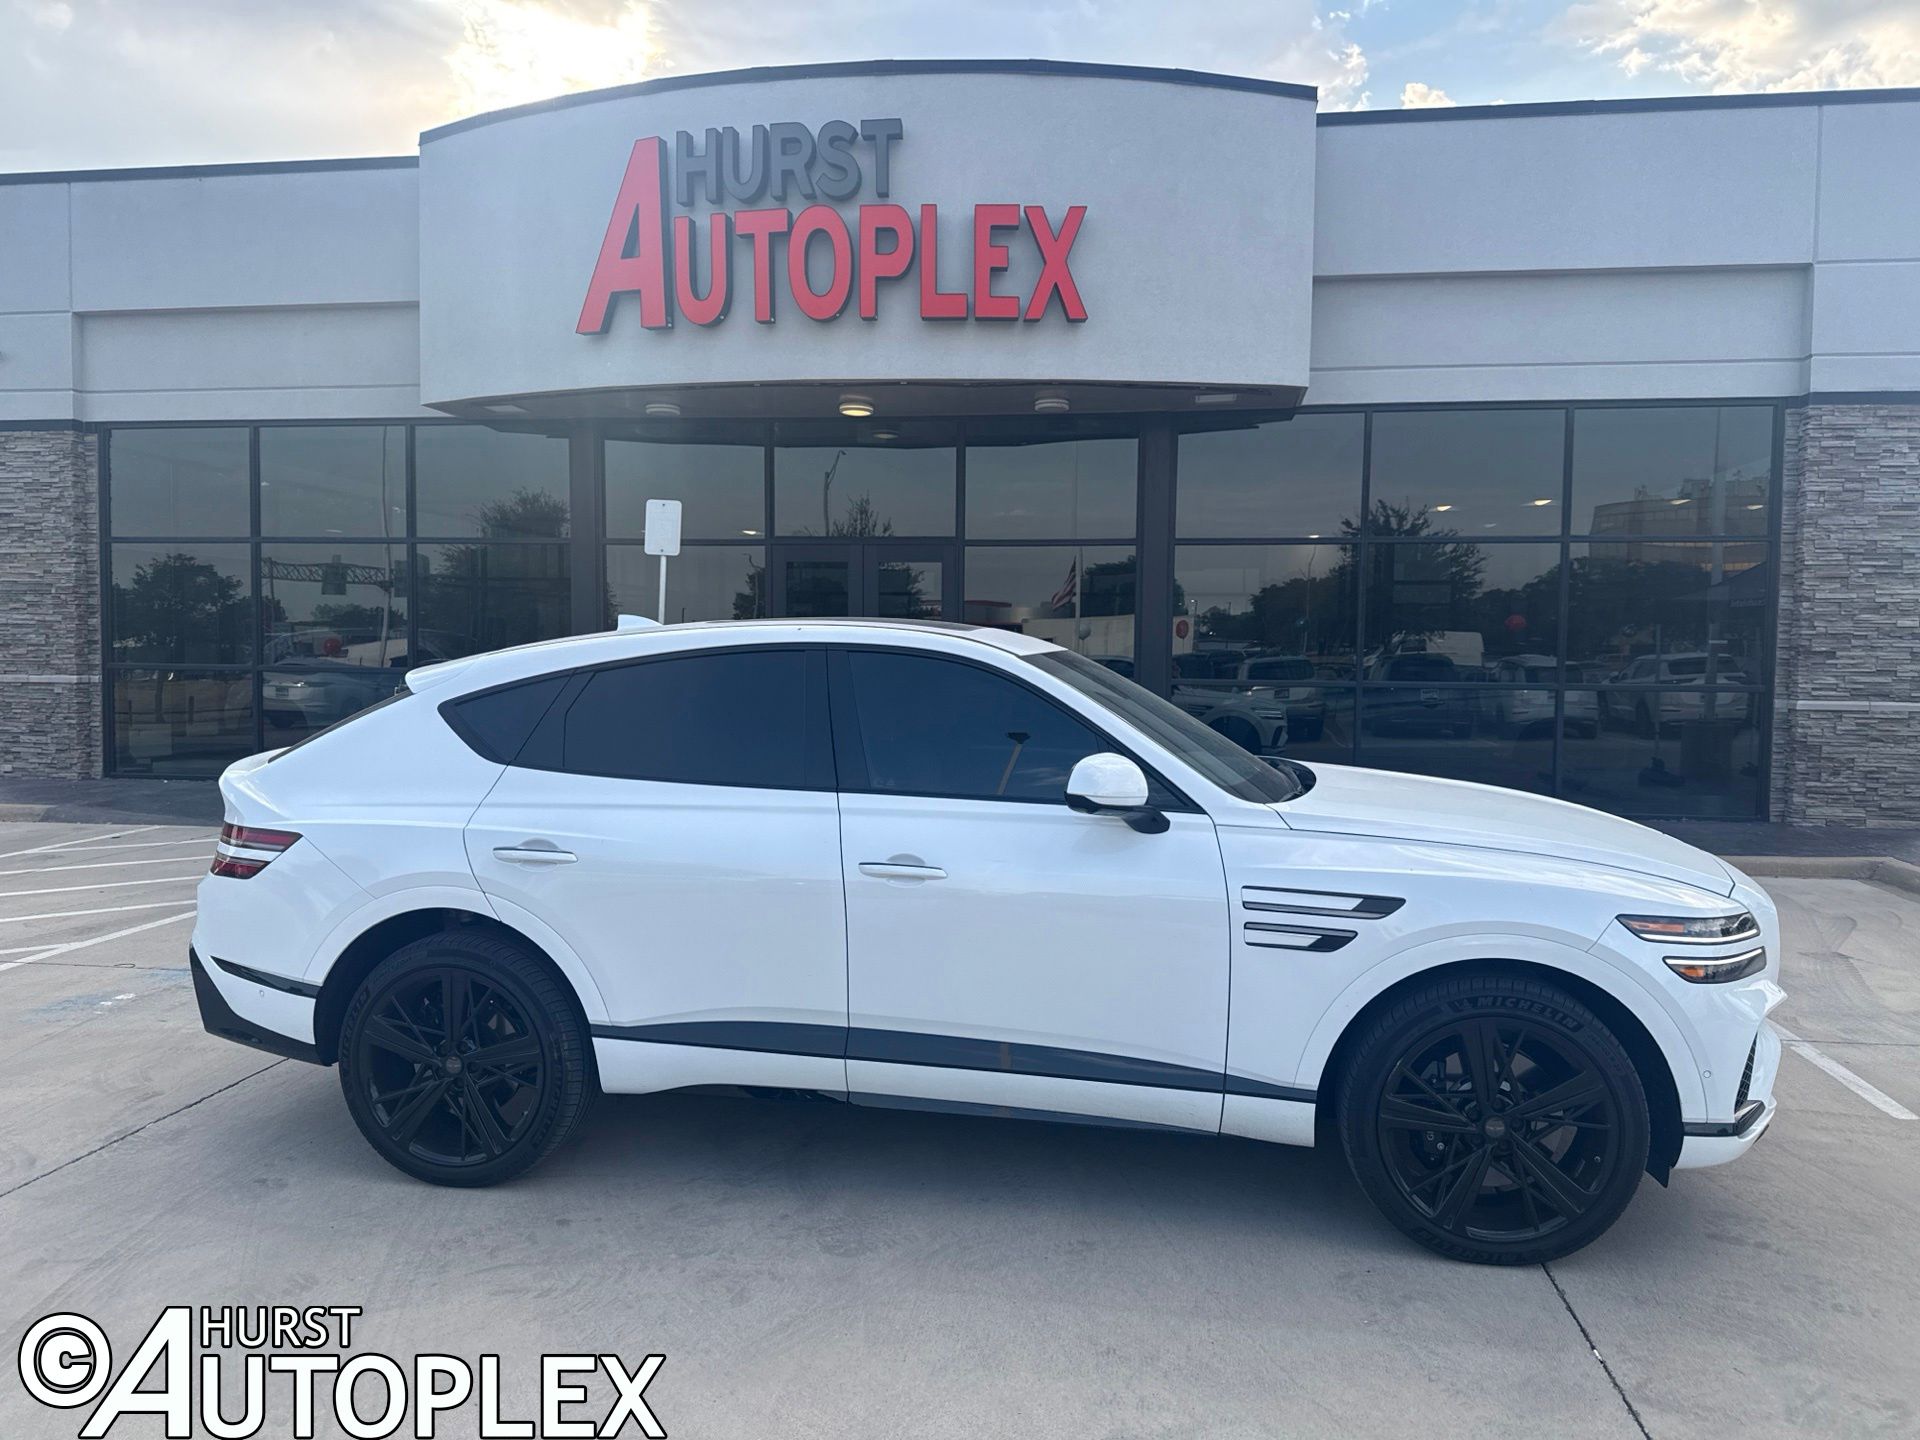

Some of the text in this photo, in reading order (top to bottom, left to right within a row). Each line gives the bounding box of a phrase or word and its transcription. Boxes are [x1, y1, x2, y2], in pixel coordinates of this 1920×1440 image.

[676, 118, 903, 207] HURST
[576, 136, 1088, 335] AUTOPLEX
[1477, 996, 1579, 1030] MICHELIN
